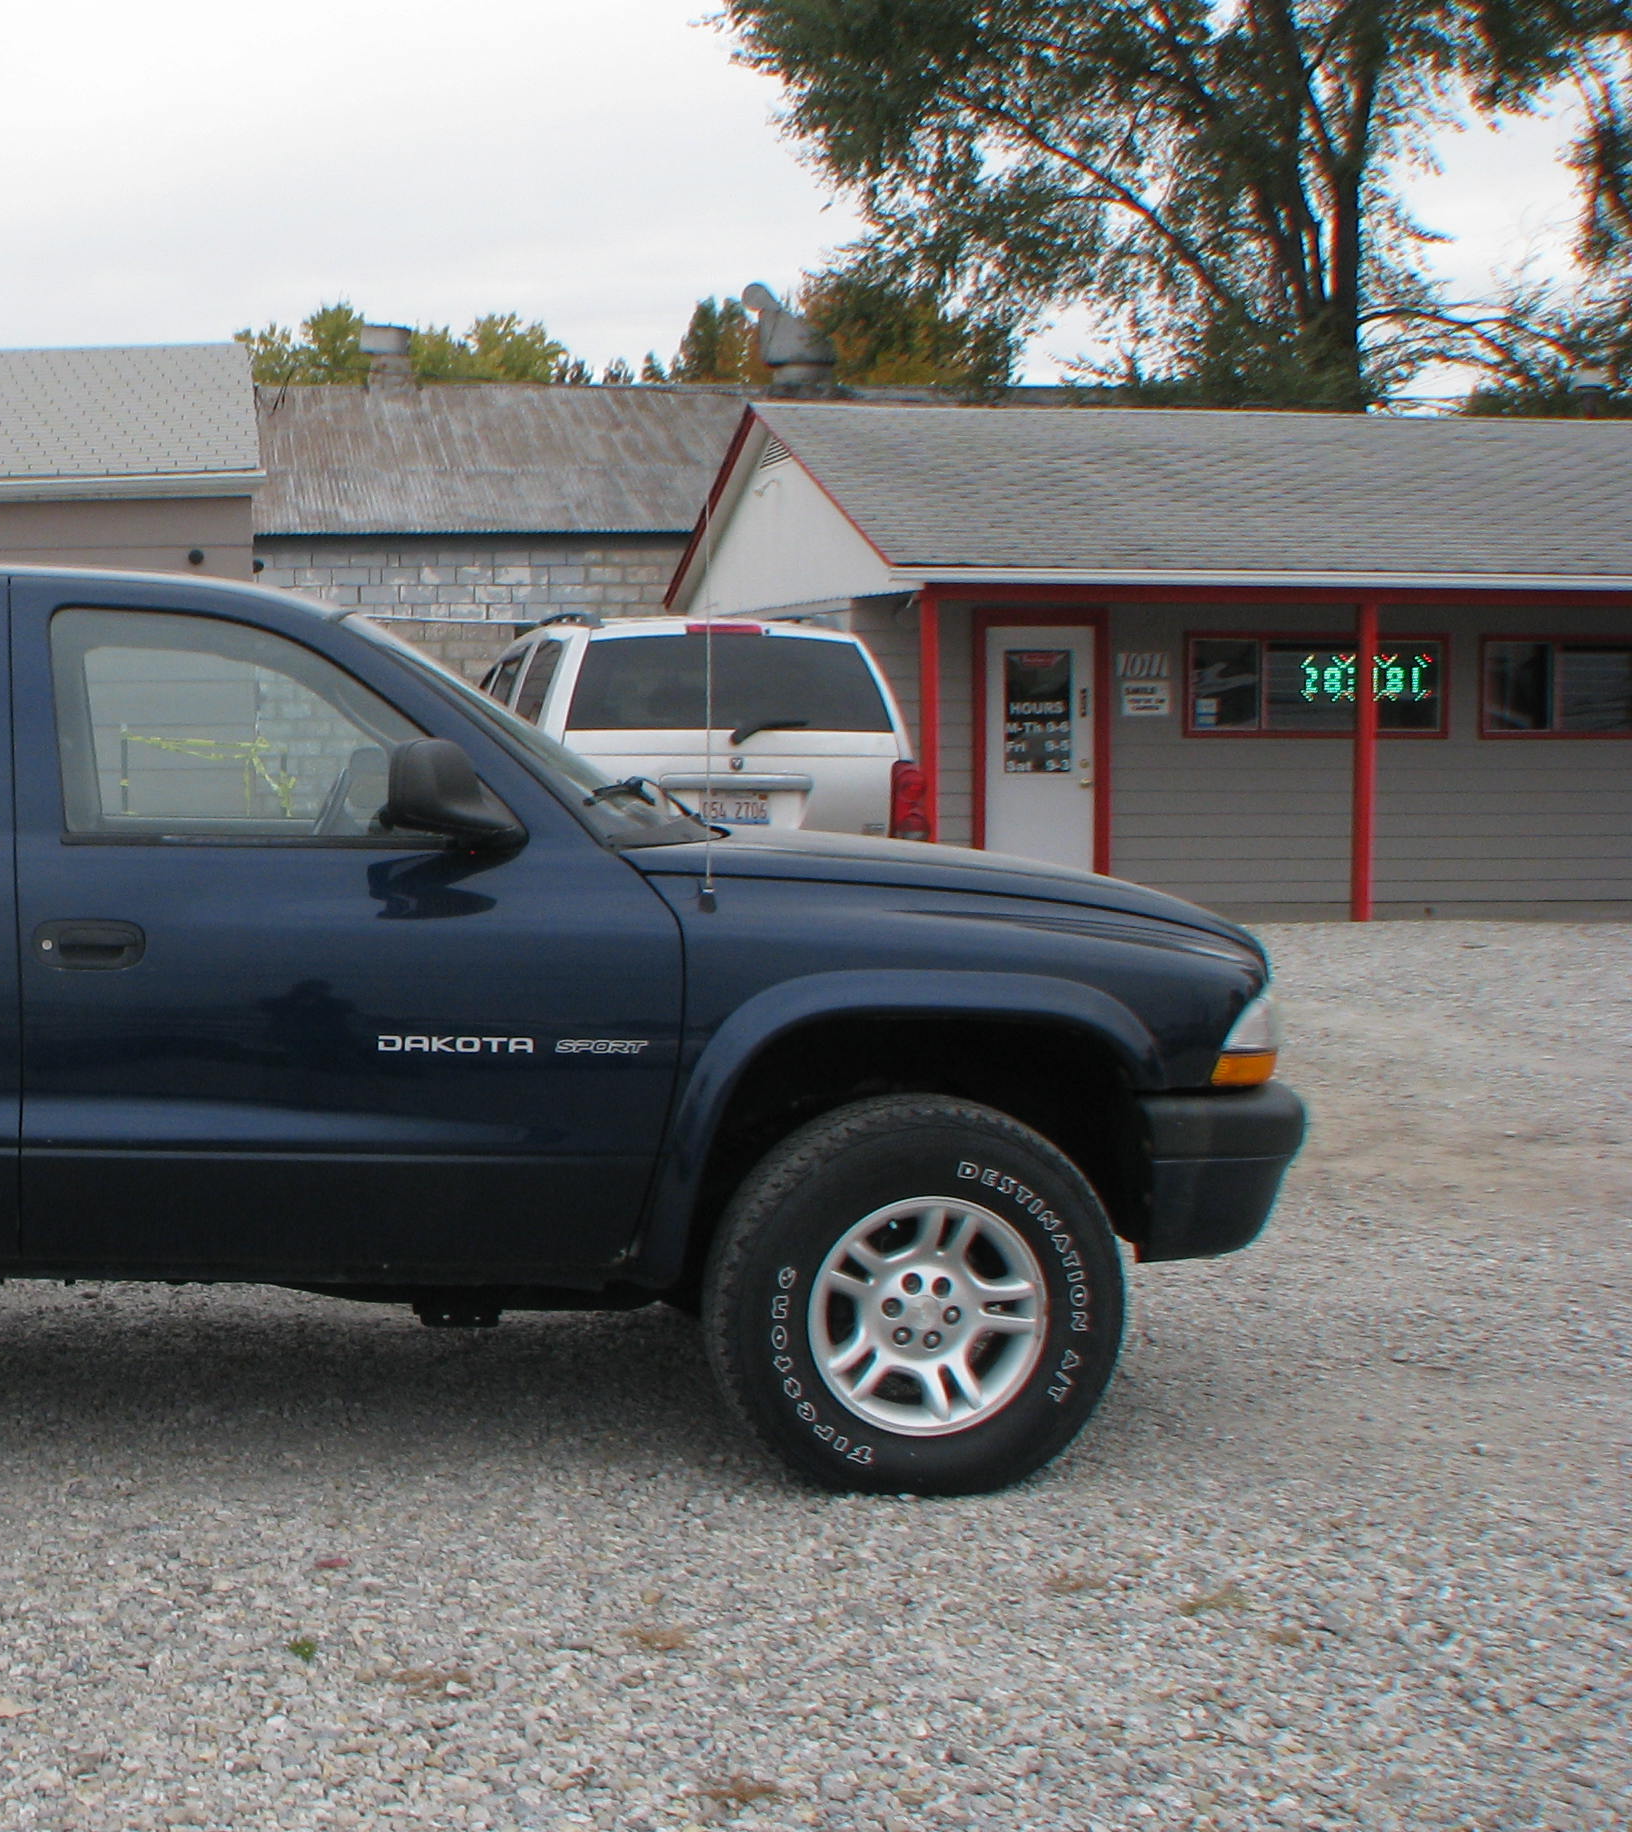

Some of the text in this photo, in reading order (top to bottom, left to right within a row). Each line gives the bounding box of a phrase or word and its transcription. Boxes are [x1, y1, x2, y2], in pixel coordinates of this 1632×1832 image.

[1009, 701, 1065, 715] HOURS
[1006, 740, 1027, 752] Fri
[1006, 760, 1033, 772] Sat
[377, 1035, 649, 1054] DAKOTA SPORT
[956, 1160, 1090, 1403] DESTINATION A/T
